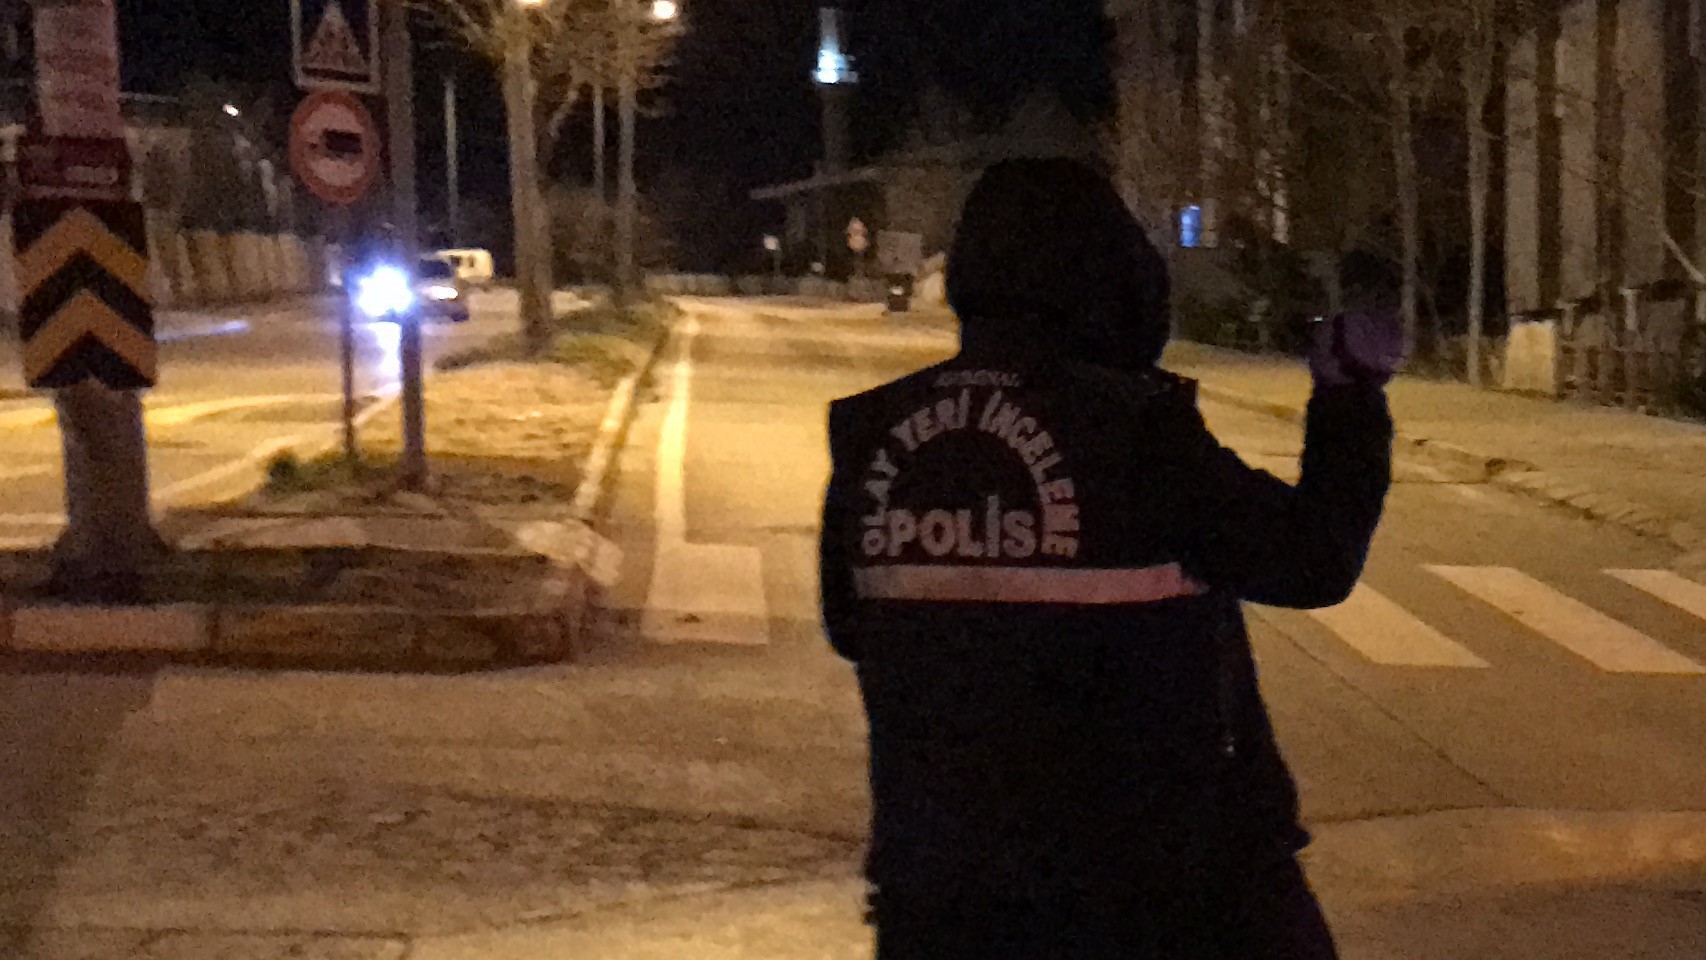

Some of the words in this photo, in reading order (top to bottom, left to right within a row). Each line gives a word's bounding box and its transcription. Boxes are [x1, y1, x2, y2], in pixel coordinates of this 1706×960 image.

[861, 448, 900, 557] OLAY
[889, 387, 972, 451] YERİ
[886, 495, 1037, 559] POLİS
